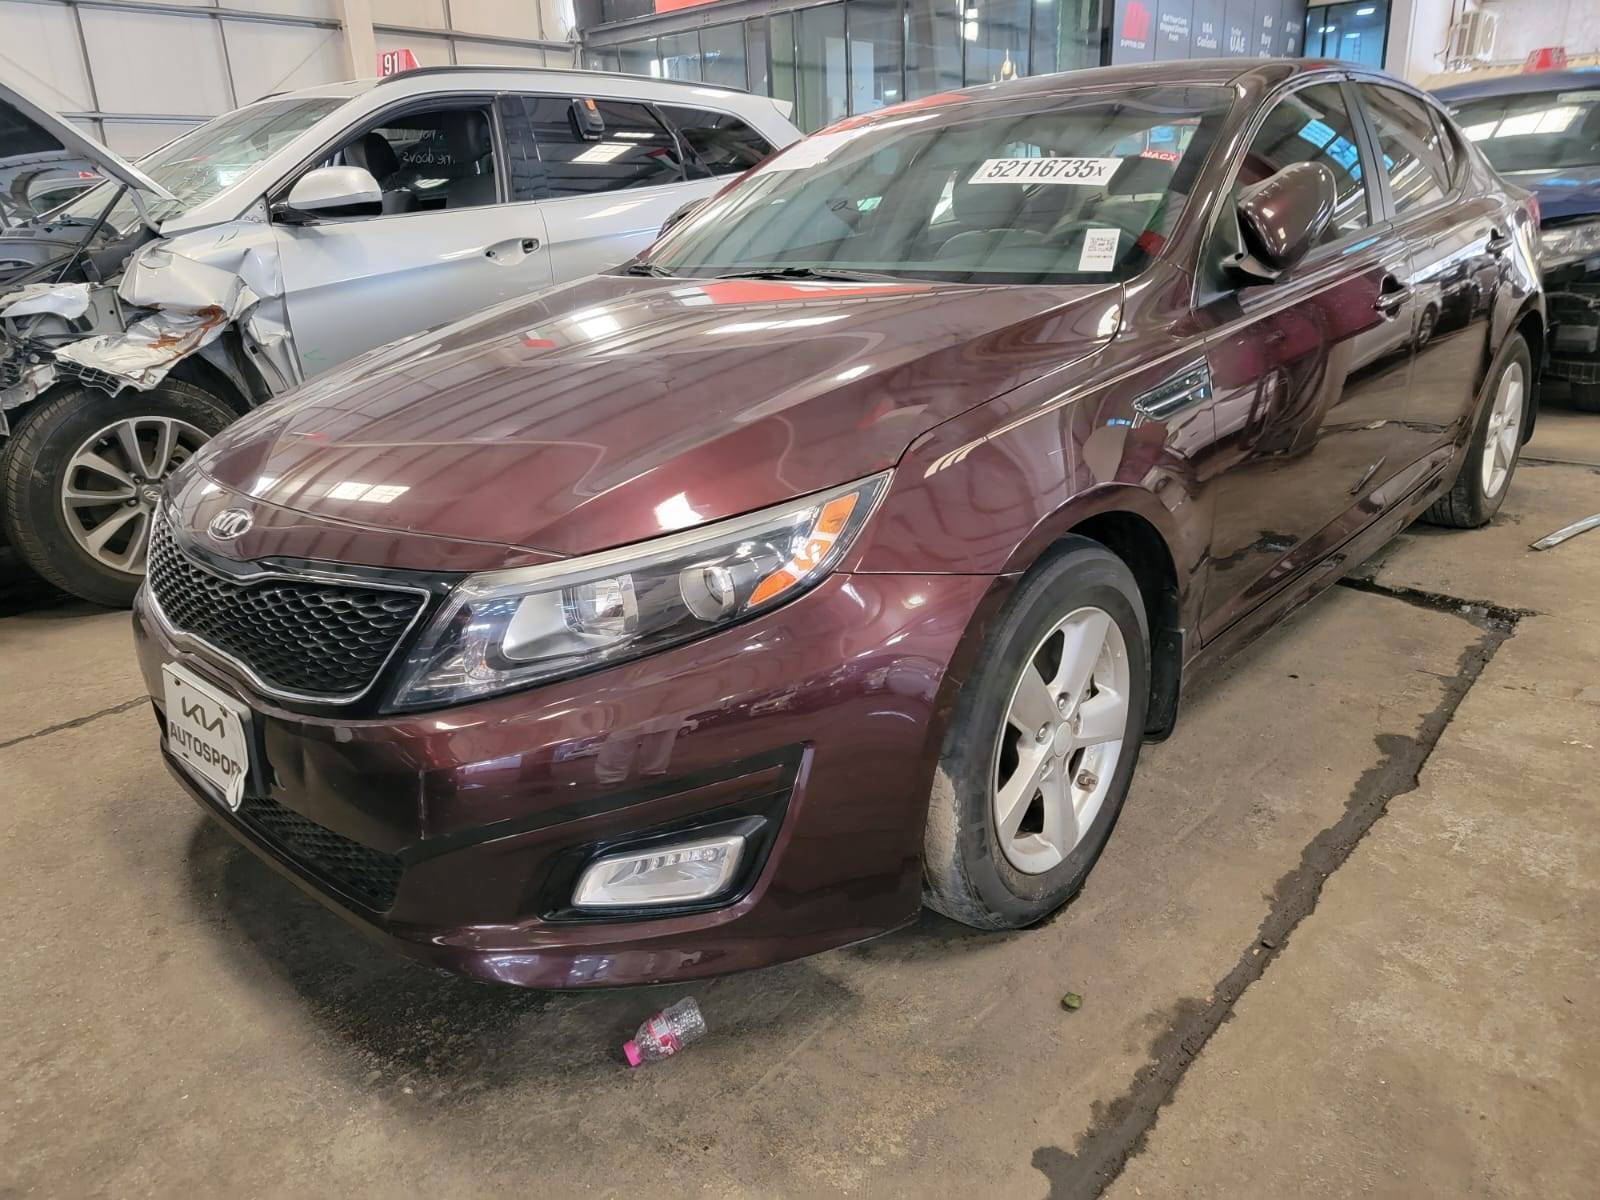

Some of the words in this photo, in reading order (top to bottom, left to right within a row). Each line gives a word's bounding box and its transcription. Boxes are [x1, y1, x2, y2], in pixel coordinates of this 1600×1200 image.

[1230, 35, 1245, 53] UAE
[384, 52, 399, 75] 91
[181, 696, 226, 739] KIA
